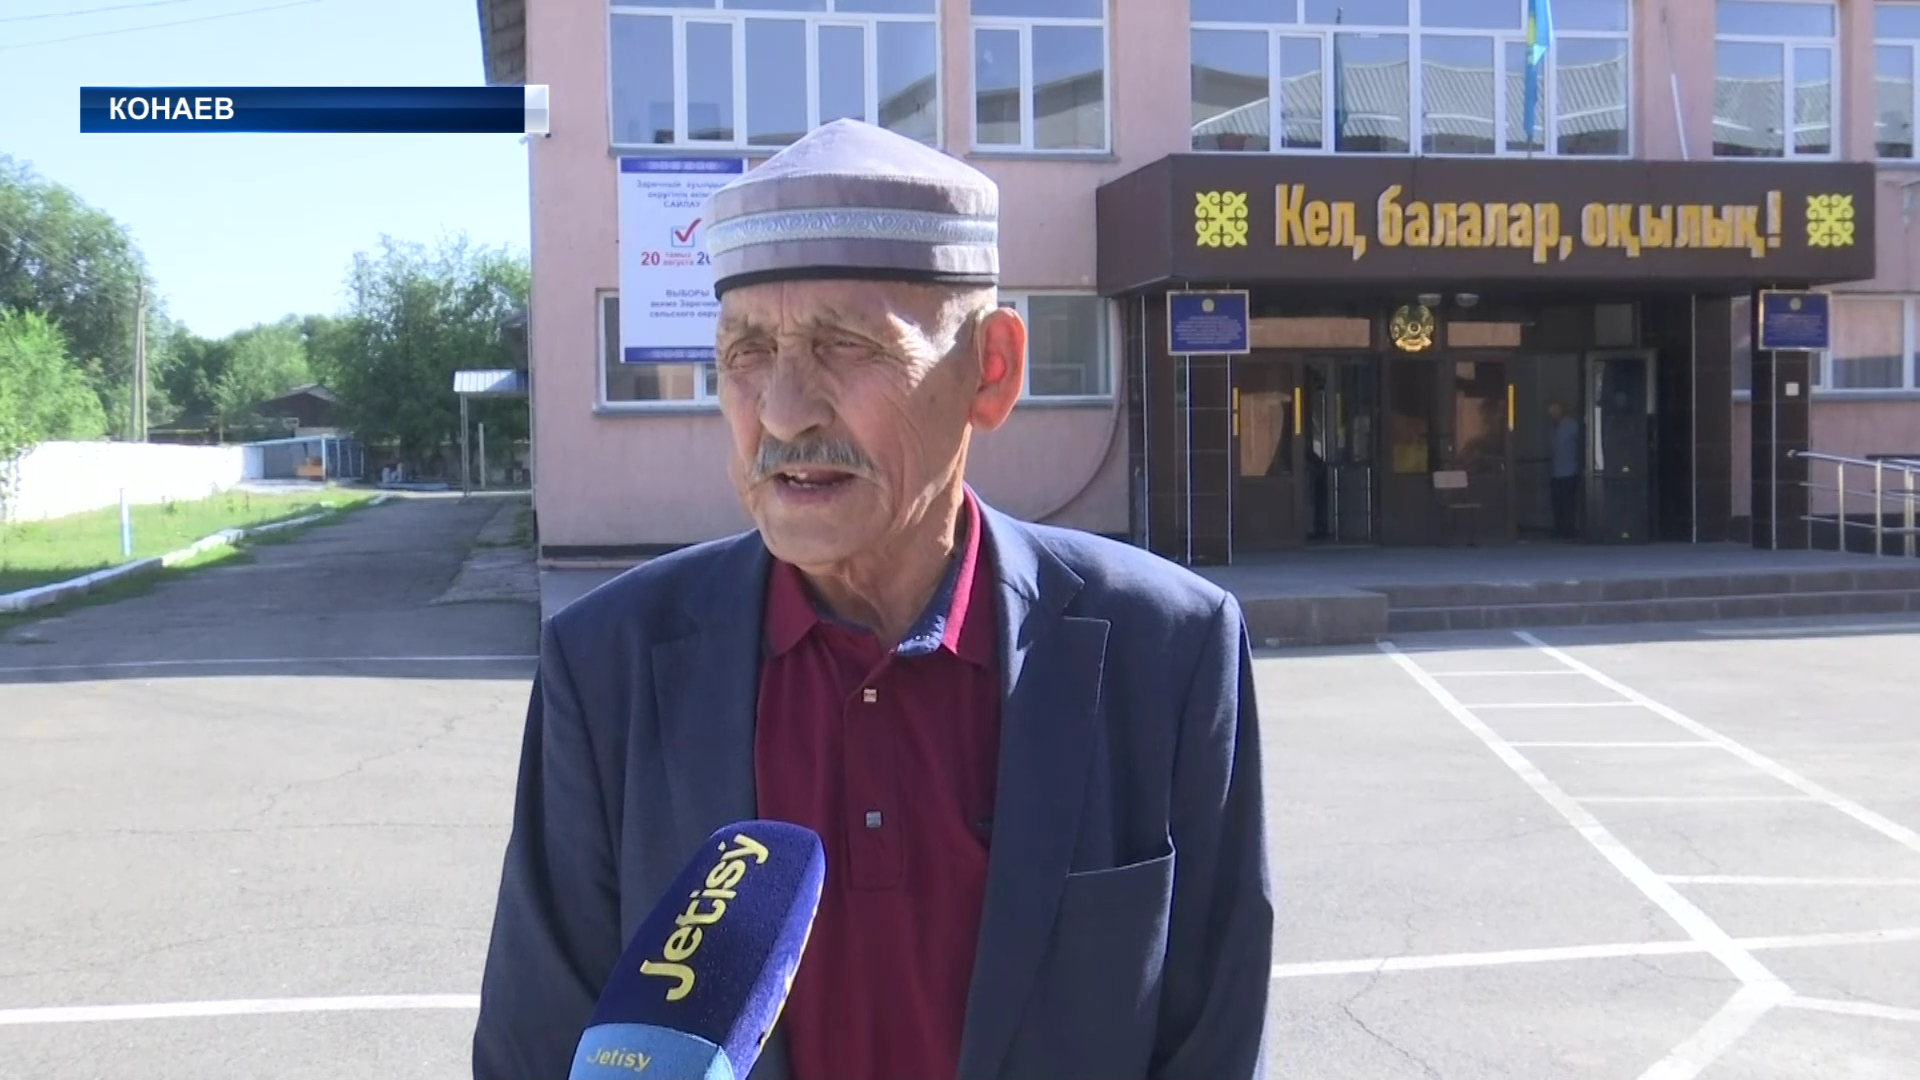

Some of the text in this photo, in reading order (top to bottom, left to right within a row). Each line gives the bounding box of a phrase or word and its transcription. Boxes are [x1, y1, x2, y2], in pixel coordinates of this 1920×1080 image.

[1275, 183, 1782, 264] Кел, балалар, оқылық!
[640, 251, 661, 266] 20
[680, 300, 719, 308] Заречно
